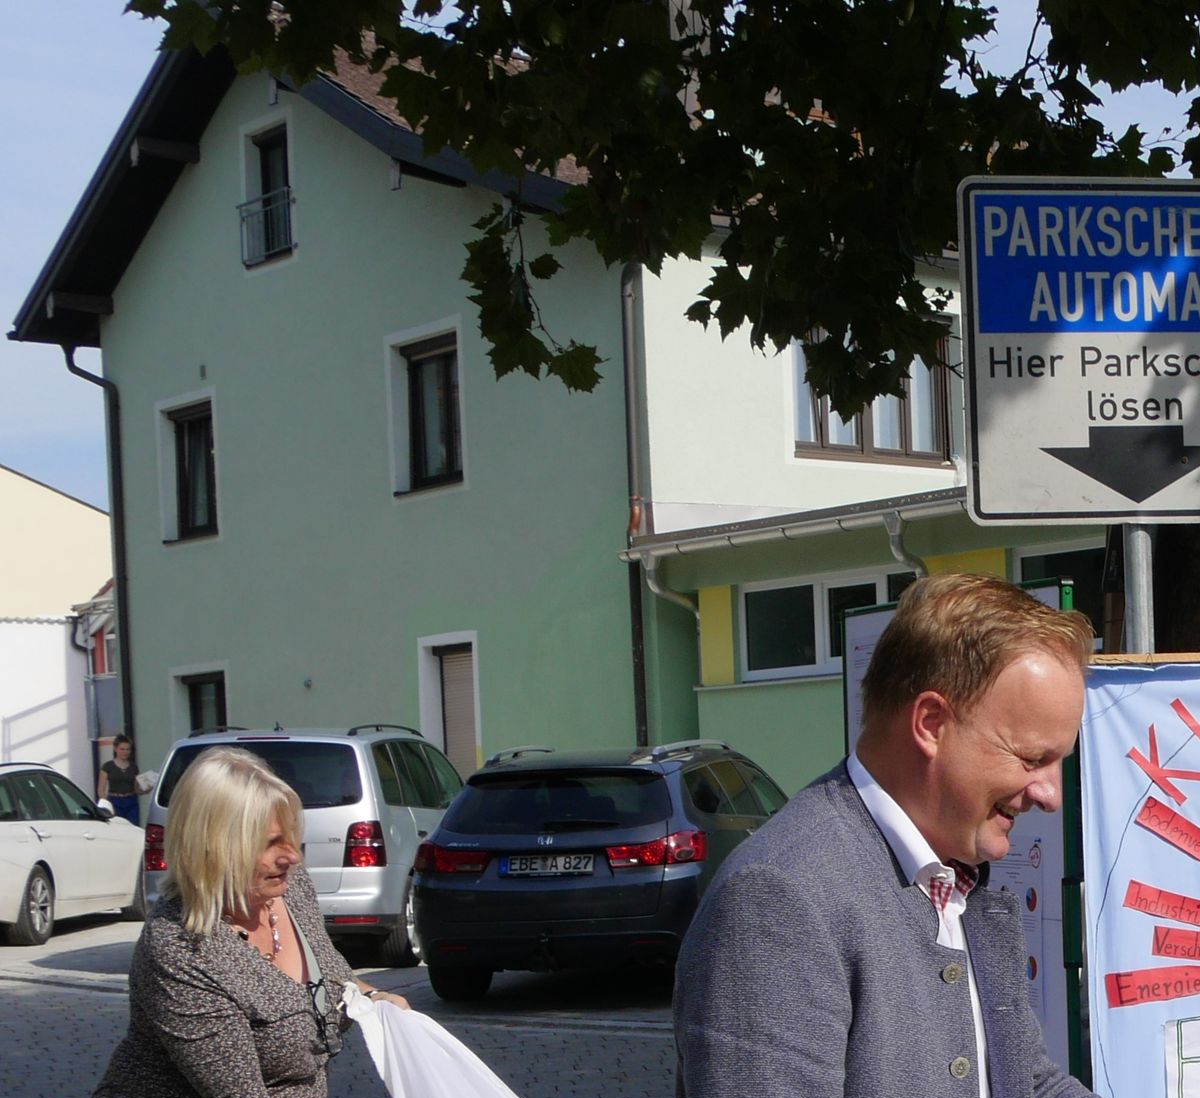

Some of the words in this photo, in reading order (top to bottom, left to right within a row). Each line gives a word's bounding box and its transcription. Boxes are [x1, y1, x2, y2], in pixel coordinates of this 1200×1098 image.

[989, 347, 1064, 378] Hier
[1087, 390, 1184, 421] lösen
[509, 856, 538, 871] EBE
[550, 856, 558, 870] A
[563, 855, 591, 870] 827
